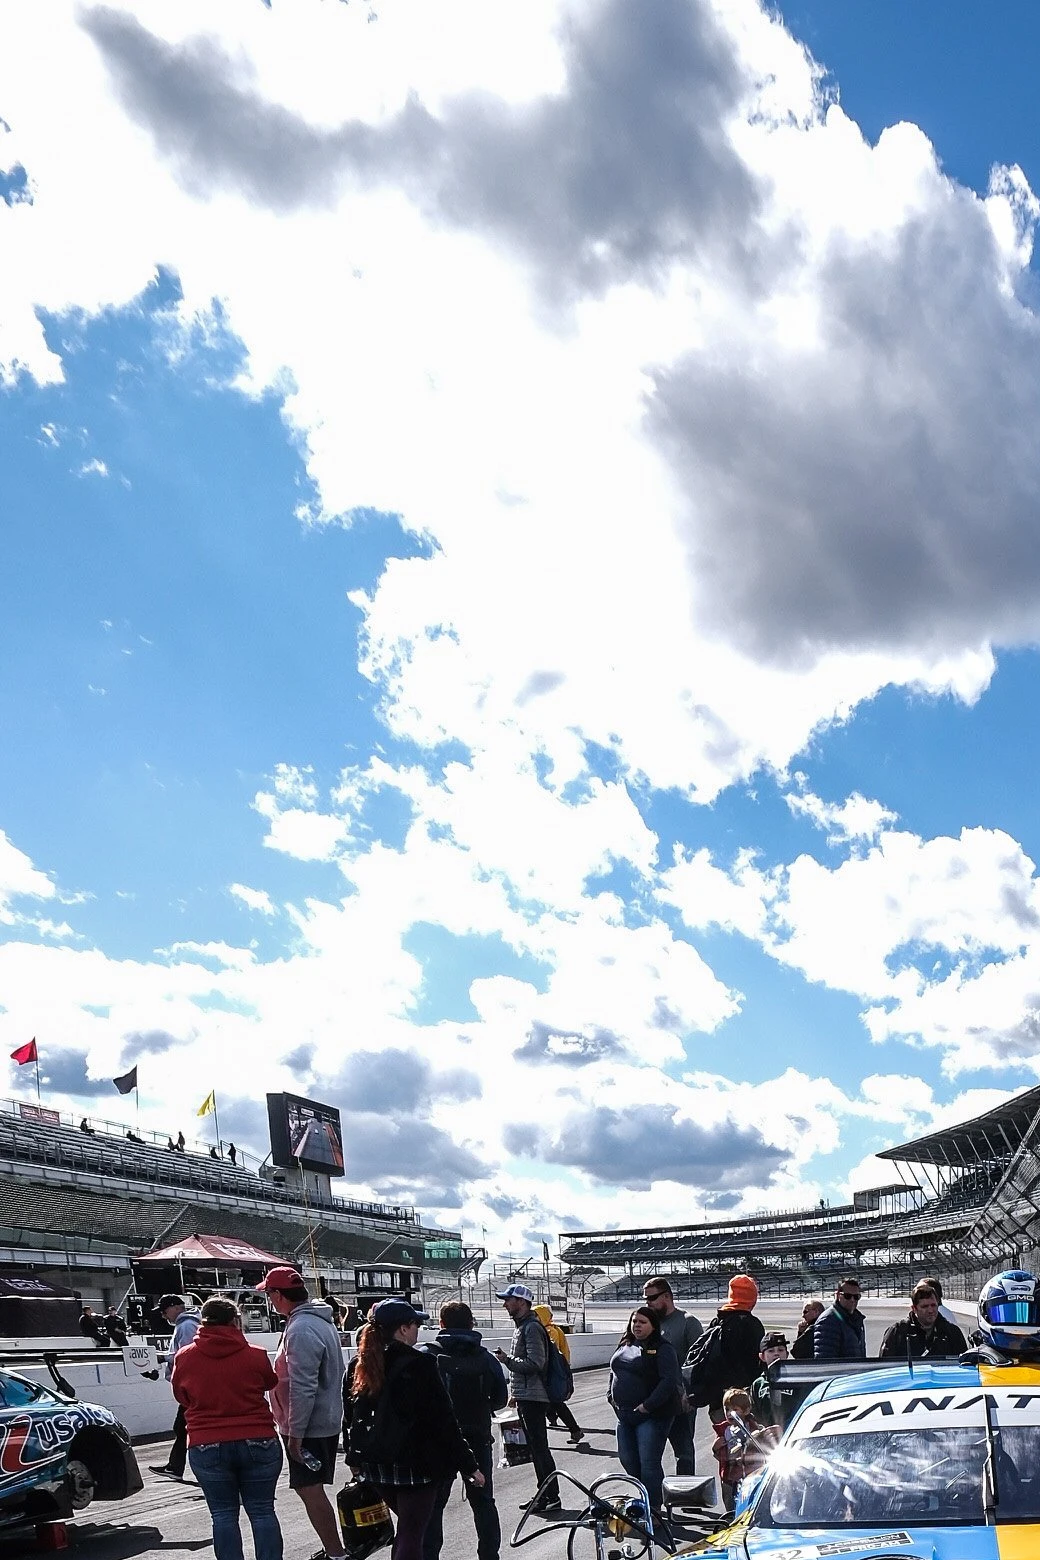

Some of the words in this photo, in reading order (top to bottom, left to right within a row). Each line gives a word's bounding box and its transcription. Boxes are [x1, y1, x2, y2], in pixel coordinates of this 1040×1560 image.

[1007, 1294, 1035, 1302] GMG
[136, 1304, 143, 1318] 3
[130, 1348, 149, 1359] aws
